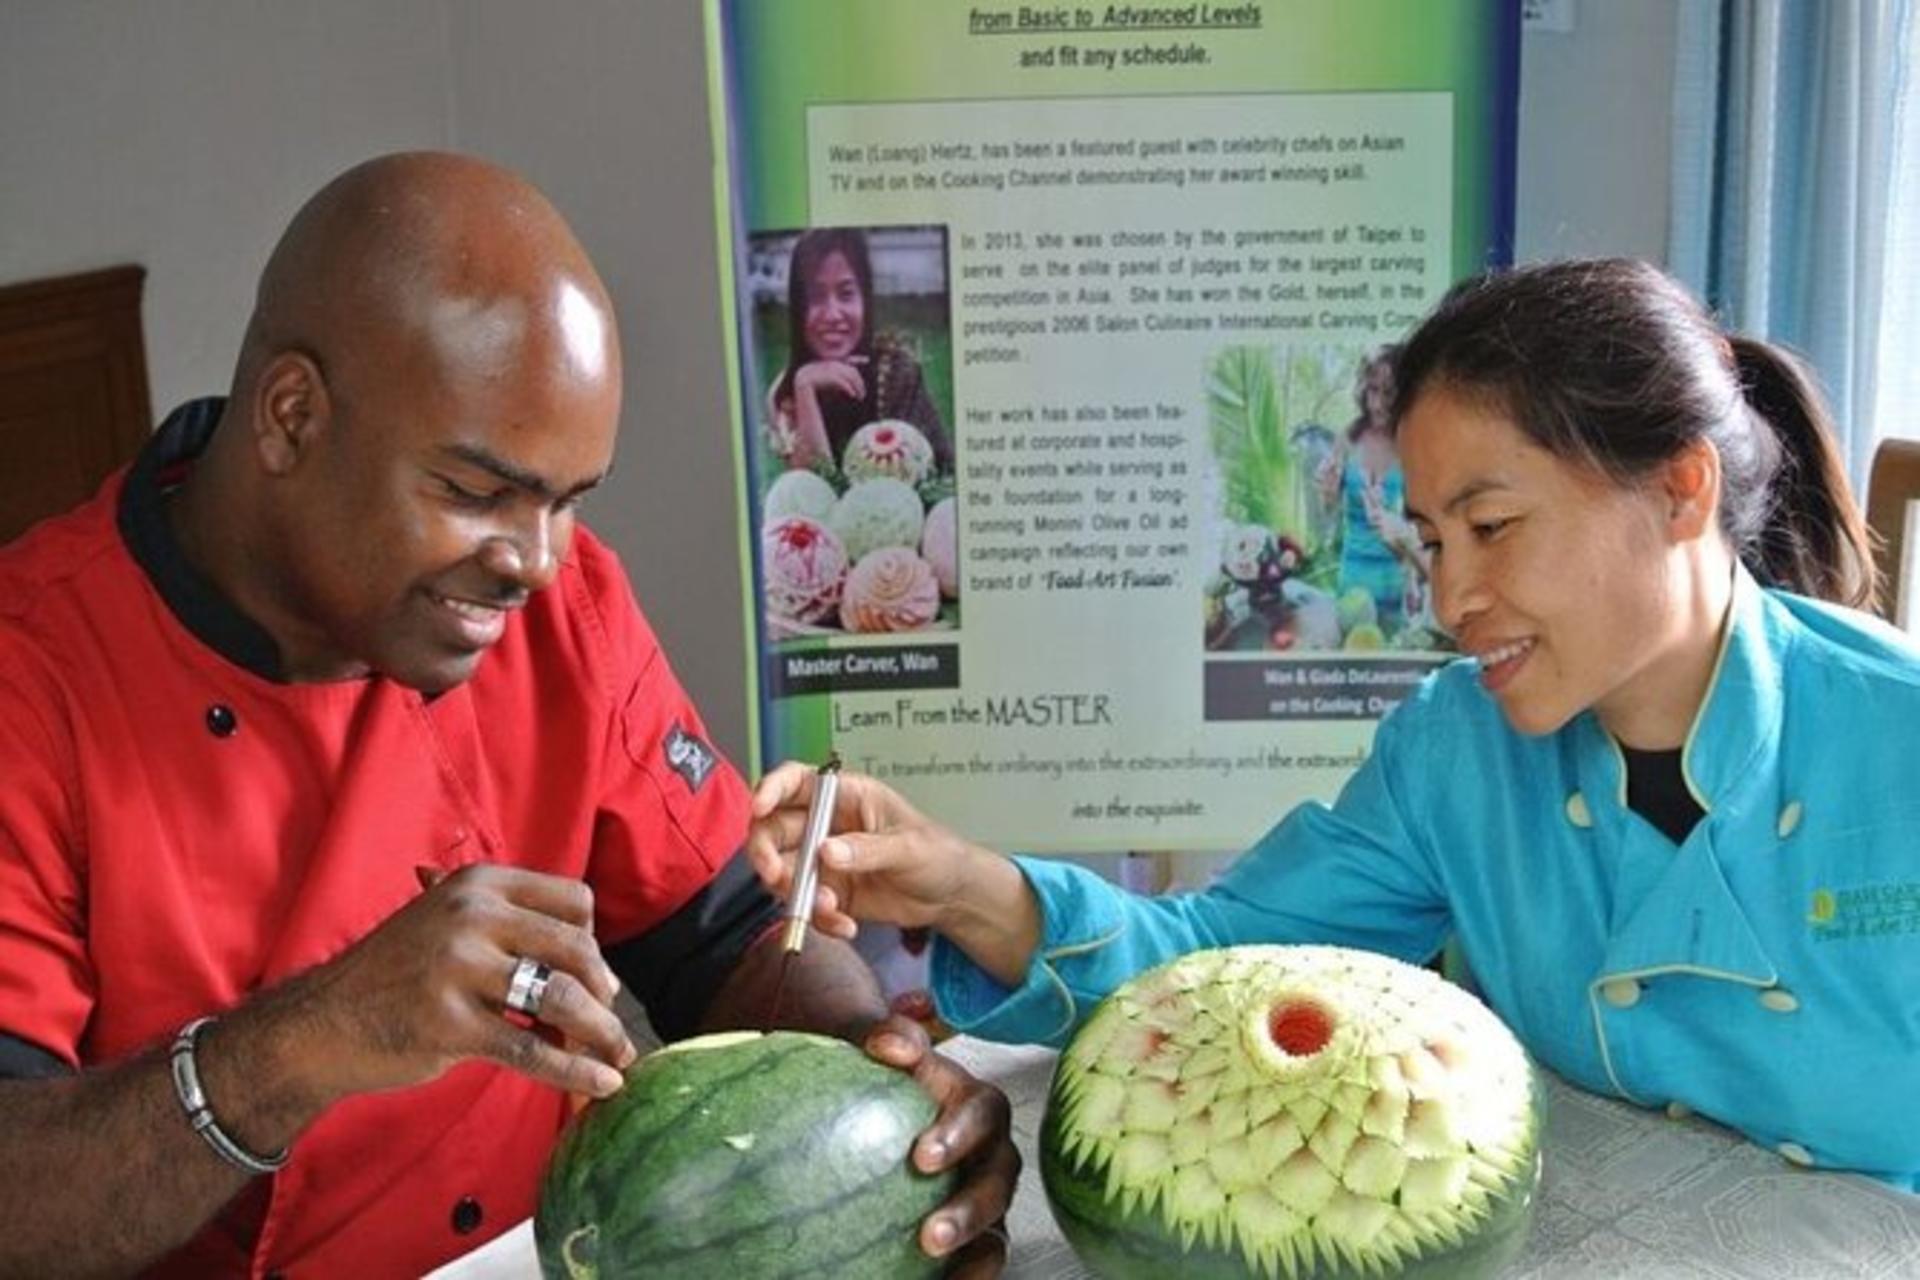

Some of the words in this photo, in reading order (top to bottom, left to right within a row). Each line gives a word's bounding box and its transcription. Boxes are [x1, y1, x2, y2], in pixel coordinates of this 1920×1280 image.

[969, 7, 1012, 29] from
[1018, 6, 1069, 28] Basic
[1075, 7, 1092, 27] to
[1104, 5, 1197, 26] Advanced
[1201, 3, 1261, 25] Levels
[1020, 46, 1054, 68] and
[1060, 45, 1078, 66] fit
[1083, 48, 1116, 70] any
[1122, 43, 1211, 65] schedule.
[830, 143, 862, 162] Wan
[981, 142, 1009, 159] has
[1014, 140, 1050, 158] been
[1056, 142, 1066, 157] a
[1071, 138, 1134, 156] featured
[1139, 137, 1181, 159] guest
[1187, 136, 1217, 155] with
[1222, 135, 1287, 157] celebrity
[1291, 134, 1333, 153] chefs
[1338, 137, 1357, 152] on
[1360, 134, 1404, 152] Asian
[830, 173, 852, 192] TV
[856, 172, 884, 191] and
[889, 175, 908, 191] on
[912, 172, 936, 190] the
[941, 169, 1004, 191] Cooking
[1009, 167, 1072, 187] Channel
[1076, 166, 1184, 187] demonstrating
[1189, 166, 1214, 182] her
[1219, 165, 1266, 182] award
[1271, 164, 1329, 184] winning
[961, 232, 976, 249] In
[1036, 231, 1063, 248] she
[1073, 233, 1102, 248] was
[1111, 231, 1165, 248] chosen
[1174, 230, 1192, 250] by
[1202, 228, 1226, 245] the
[1234, 228, 1324, 248] government
[1332, 227, 1348, 244] of
[1358, 225, 1402, 245] Taipei
[1411, 227, 1425, 243] to
[962, 263, 1003, 279] serve
[1019, 263, 1039, 277] on
[1047, 260, 1070, 277] the
[1078, 260, 1110, 276] elite
[1118, 259, 1160, 279] panel
[1168, 257, 1184, 275] of
[1190, 257, 1241, 278] judges
[1250, 256, 1270, 274] for
[1277, 256, 1302, 273] the
[1310, 256, 1362, 276] largest
[1371, 256, 1425, 275] carving
[963, 289, 1049, 309] competition
[1056, 289, 1070, 305] in
[1130, 285, 1159, 304] She
[1166, 285, 1193, 303] has
[1201, 286, 1231, 302] won
[1237, 285, 1262, 301] the
[1380, 284, 1394, 299] in
[1401, 283, 1425, 299] the
[964, 317, 1046, 339] prestigious
[1052, 314, 1089, 334] 2006
[1096, 314, 1139, 334] Salon
[1145, 312, 1212, 331] Culinaire
[1218, 311, 1313, 330] International
[1319, 310, 1377, 331] Carving
[966, 406, 992, 424] Her
[1001, 406, 1034, 423] work
[1041, 406, 1068, 422] has
[1075, 405, 1107, 422] also
[1112, 404, 1150, 421] been
[1156, 402, 1186, 420] fea-
[967, 435, 1005, 452] tured
[1012, 434, 1026, 451] at
[1030, 434, 1102, 452] corporate
[1107, 434, 1135, 450] and
[1140, 432, 1187, 451] hospi-
[967, 463, 1003, 483] tality
[1009, 463, 1058, 478] events
[1065, 460, 1103, 477] while
[1109, 461, 1163, 479] serving
[1170, 461, 1187, 476] as
[968, 489, 992, 506] the
[1004, 488, 1083, 505] foundation
[1096, 486, 1115, 504] for
[1128, 489, 1138, 504] a
[1149, 487, 1187, 505] long-
[969, 519, 1025, 537] running
[1035, 515, 1083, 532] Monini
[1092, 514, 1130, 532] Olive
[1139, 513, 1160, 530] Oil
[1170, 514, 1188, 530] ad
[970, 545, 1041, 563] campaign
[1050, 542, 1117, 561] reflecting
[1125, 543, 1151, 558] our
[1157, 543, 1188, 558] own
[970, 573, 1013, 592] brand
[1018, 572, 1032, 590] of
[787, 655, 842, 679] Master
[845, 652, 900, 675] Carver,
[901, 651, 938, 671] Wan
[1263, 668, 1293, 685] Wan
[1297, 668, 1307, 684] &
[1309, 668, 1346, 684] Giada
[835, 702, 892, 733] Learn
[896, 699, 948, 730] From
[951, 699, 980, 725] the
[985, 694, 1112, 726] MASTER
[1269, 699, 1287, 713] on
[1290, 697, 1310, 713] the
[1313, 696, 1363, 716] Cooking
[861, 755, 887, 777] To
[891, 753, 964, 776] transform
[969, 753, 996, 775] the
[1000, 752, 1063, 780] ordinary
[1066, 756, 1097, 773] into
[1101, 749, 1123, 771] the
[1127, 748, 1232, 777] extraordinary
[1236, 750, 1264, 770] and
[1268, 746, 1292, 769] the
[1073, 799, 1102, 819] into
[1106, 794, 1129, 818] the
